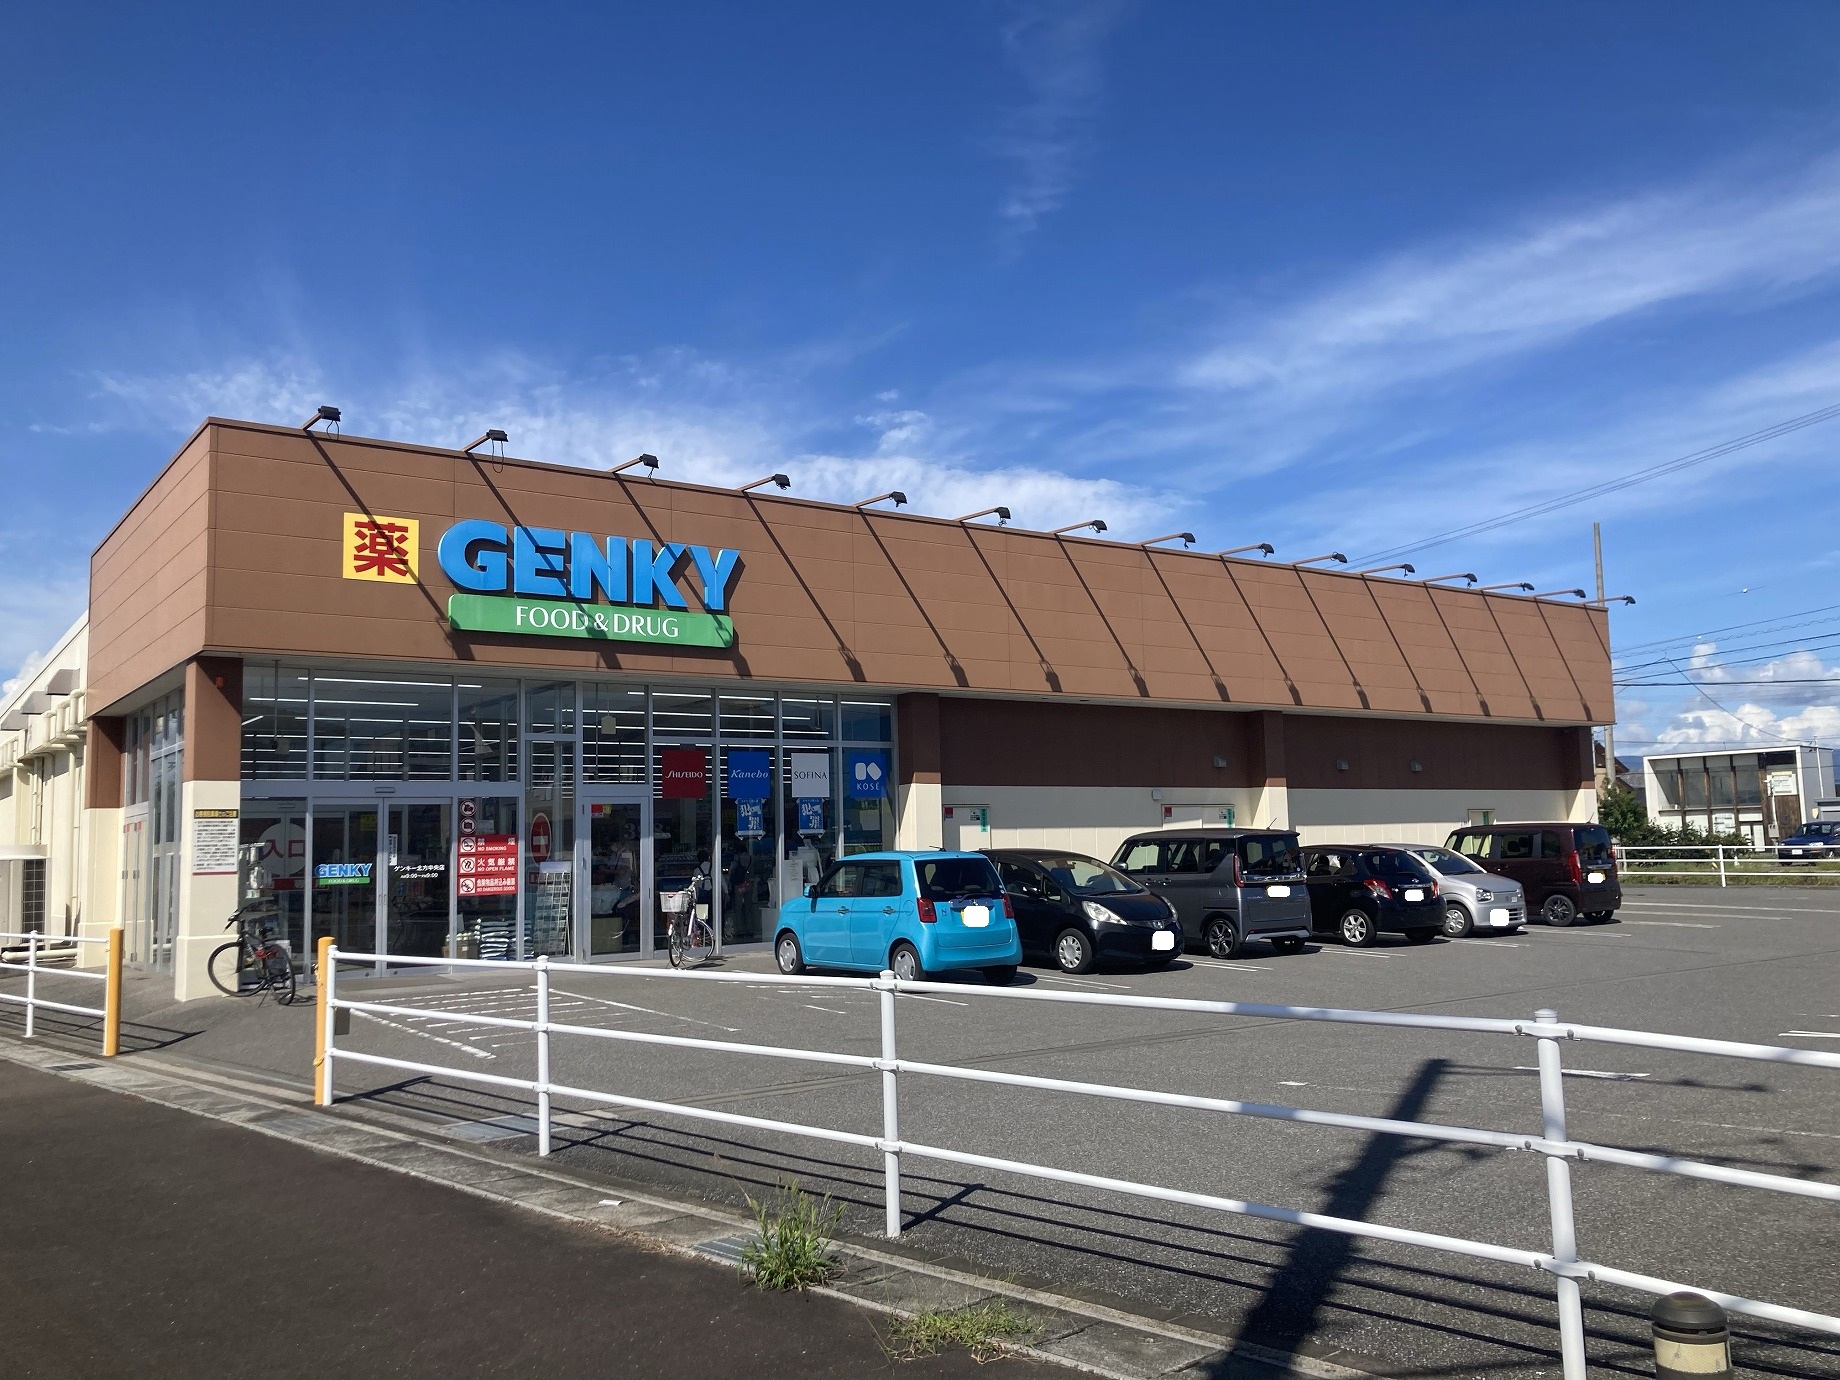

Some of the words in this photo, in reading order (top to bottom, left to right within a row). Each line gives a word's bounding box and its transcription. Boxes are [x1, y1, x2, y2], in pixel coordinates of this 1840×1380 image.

[354, 520, 409, 576] 薬
[437, 519, 741, 610] GENKY
[516, 606, 589, 630] FOOD
[613, 613, 679, 638] DRUG
[665, 770, 703, 779] SHISEIDO
[730, 769, 769, 779] Kanebo
[793, 770, 828, 780] SOFINA
[478, 858, 516, 866] 火気厳禁
[315, 863, 373, 877] GENKY
